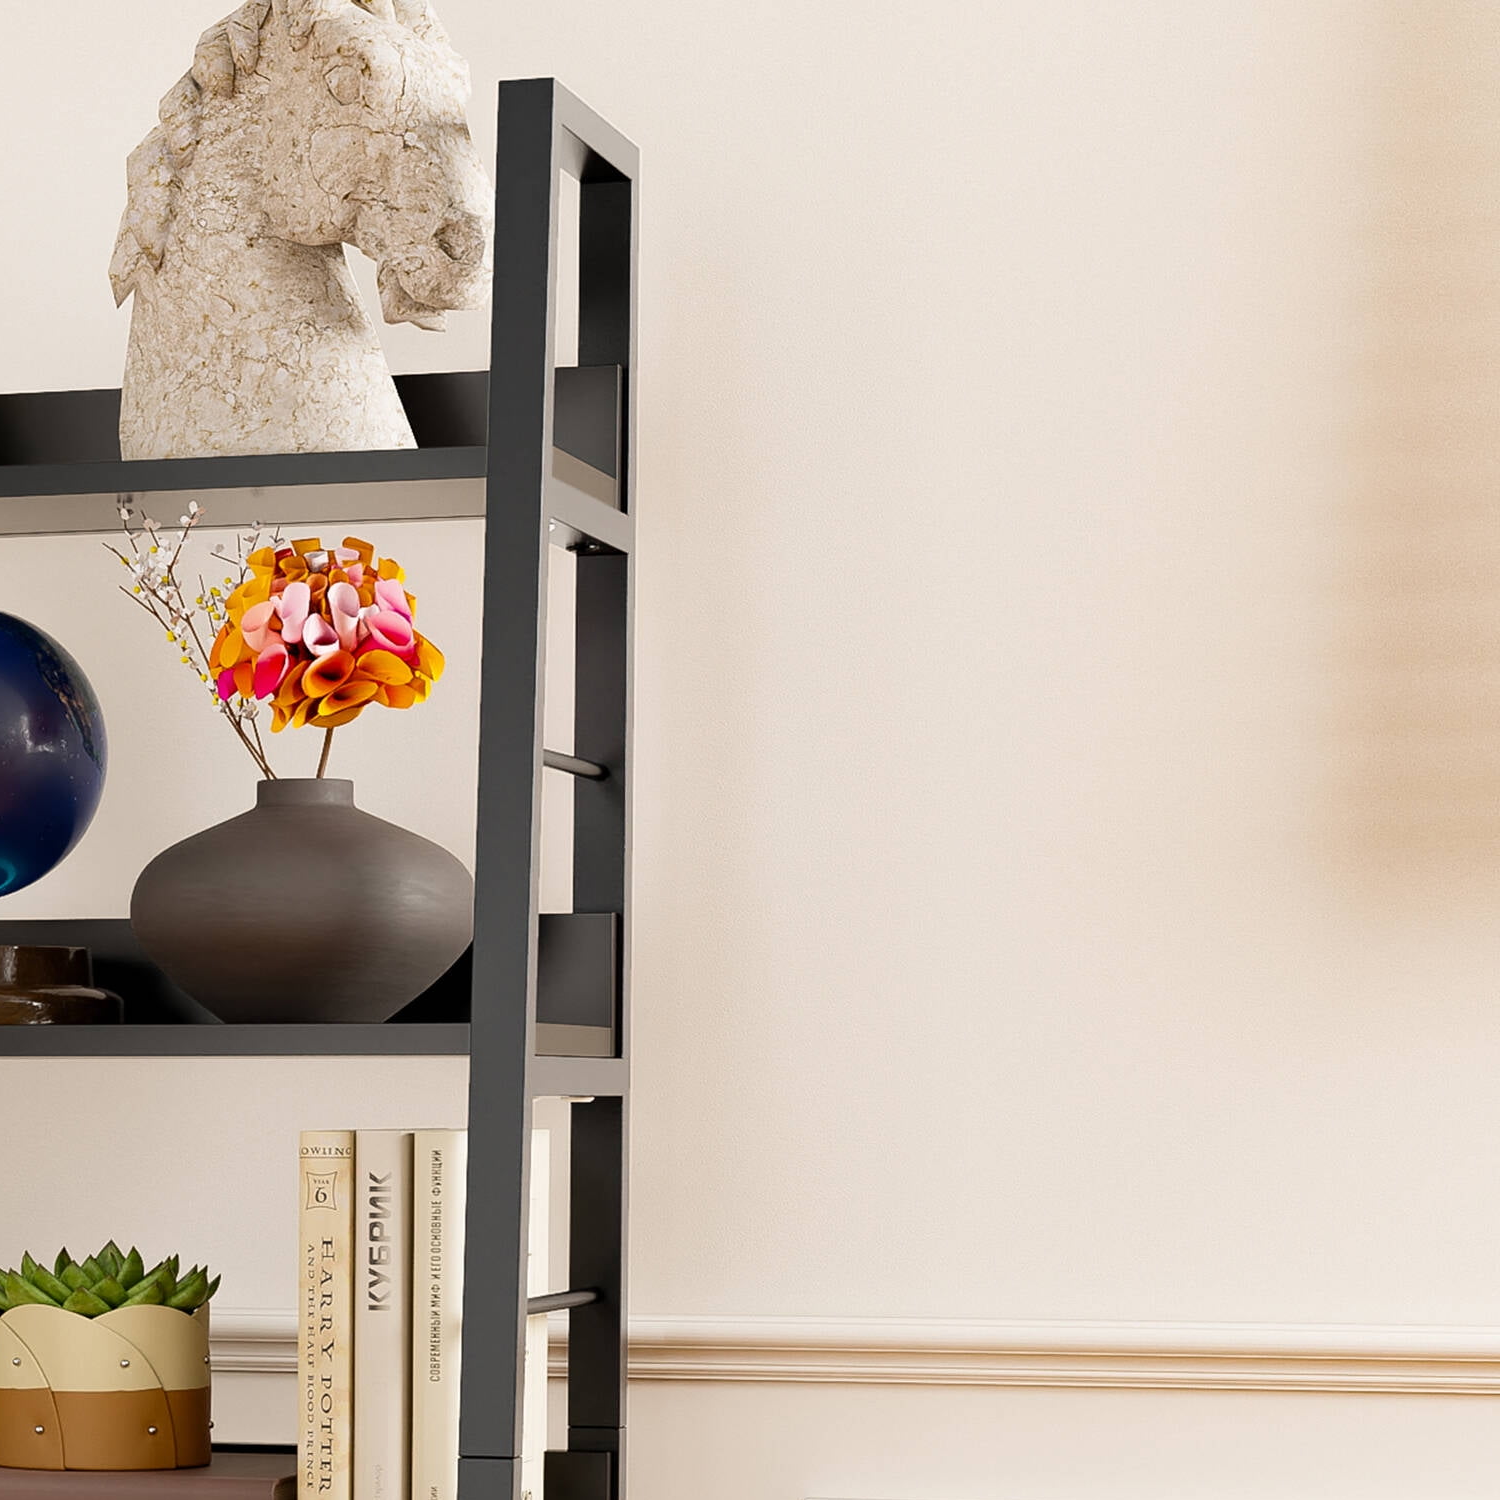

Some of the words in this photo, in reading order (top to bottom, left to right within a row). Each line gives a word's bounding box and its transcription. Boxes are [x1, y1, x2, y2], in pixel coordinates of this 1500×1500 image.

[315, 1187, 327, 1203] 6
[368, 1171, 392, 1311] КУБРИК
[430, 1200, 441, 1254] ОСНОВНЫЕ
[307, 1244, 316, 1280] AND
[430, 1255, 441, 1271] ЕГО
[320, 1237, 335, 1362] HARRY
[430, 1283, 441, 1308] МИФ
[319, 1374, 333, 1495] POTTER
